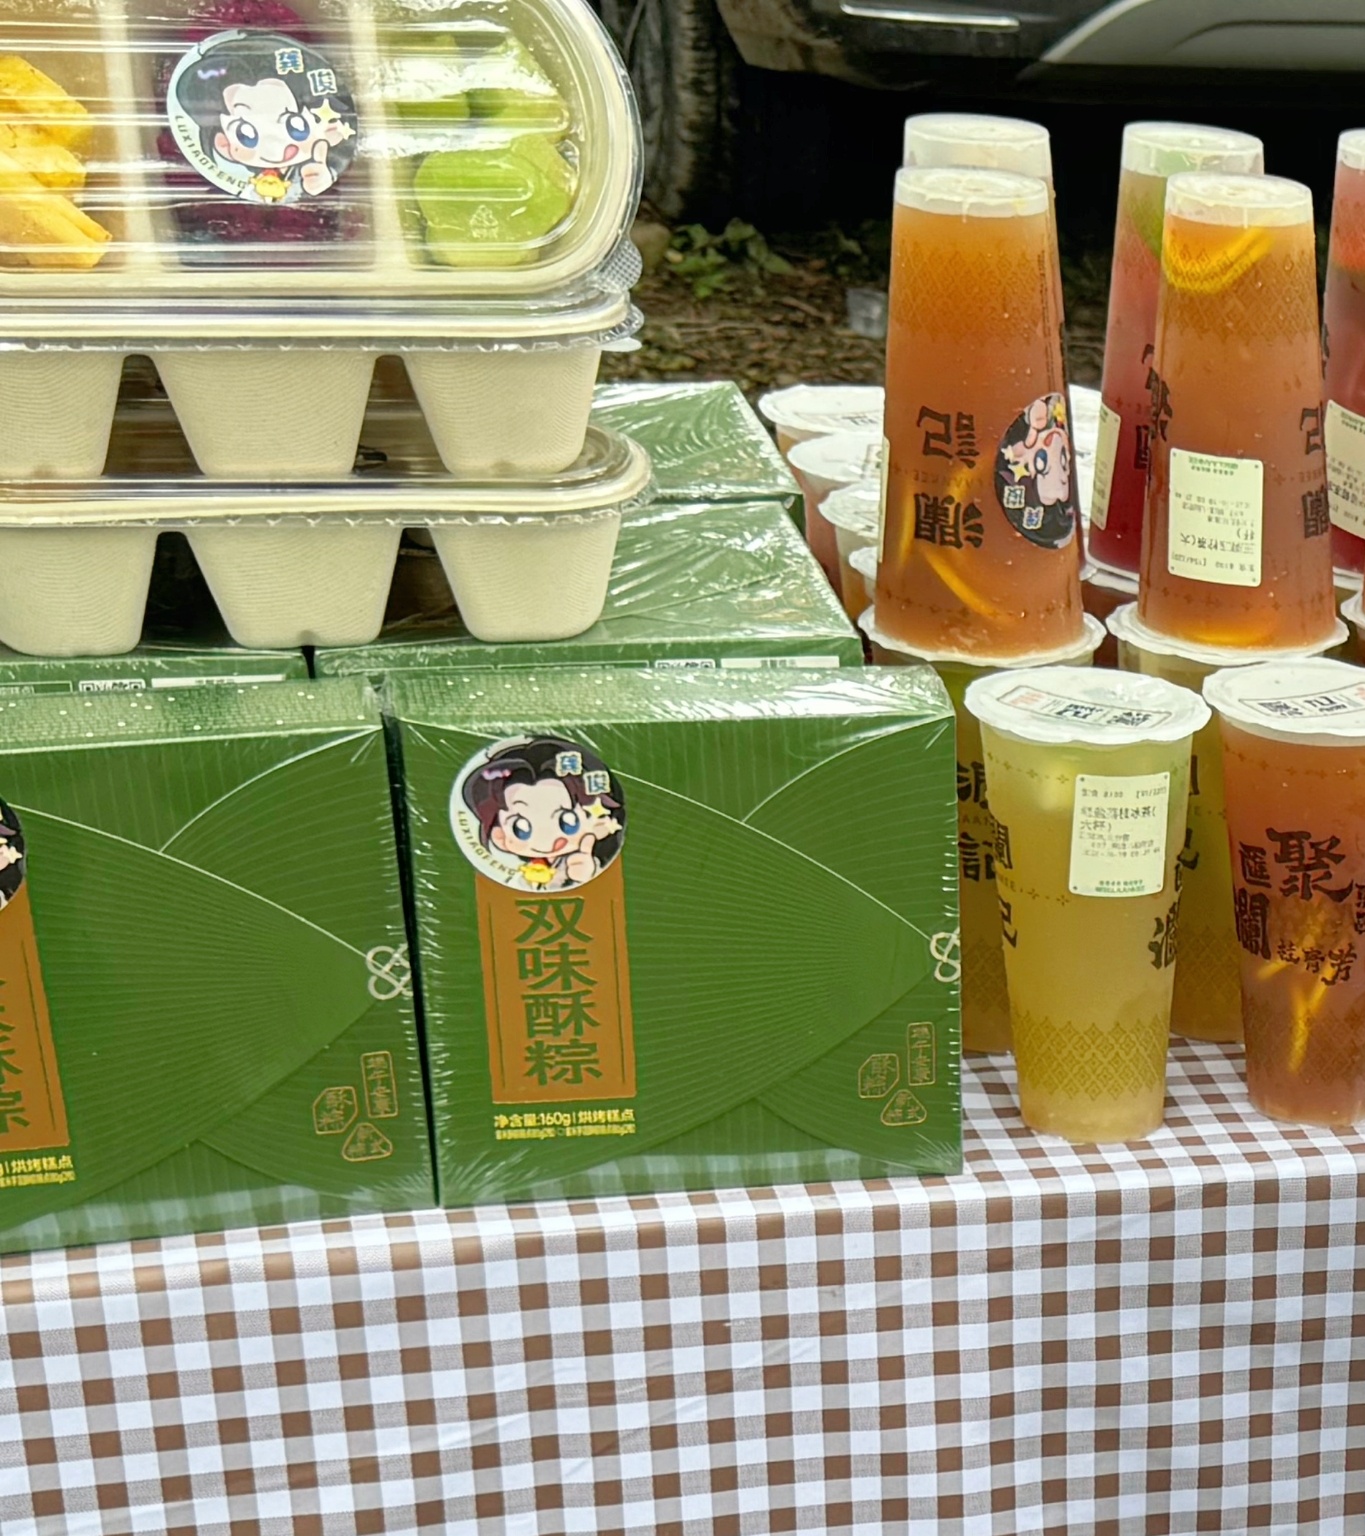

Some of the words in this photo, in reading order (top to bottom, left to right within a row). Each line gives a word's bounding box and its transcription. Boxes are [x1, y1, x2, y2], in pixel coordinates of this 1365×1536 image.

[174, 114, 249, 190] LUXIAOFENG
[514, 896, 603, 1086] 双味酥粽
